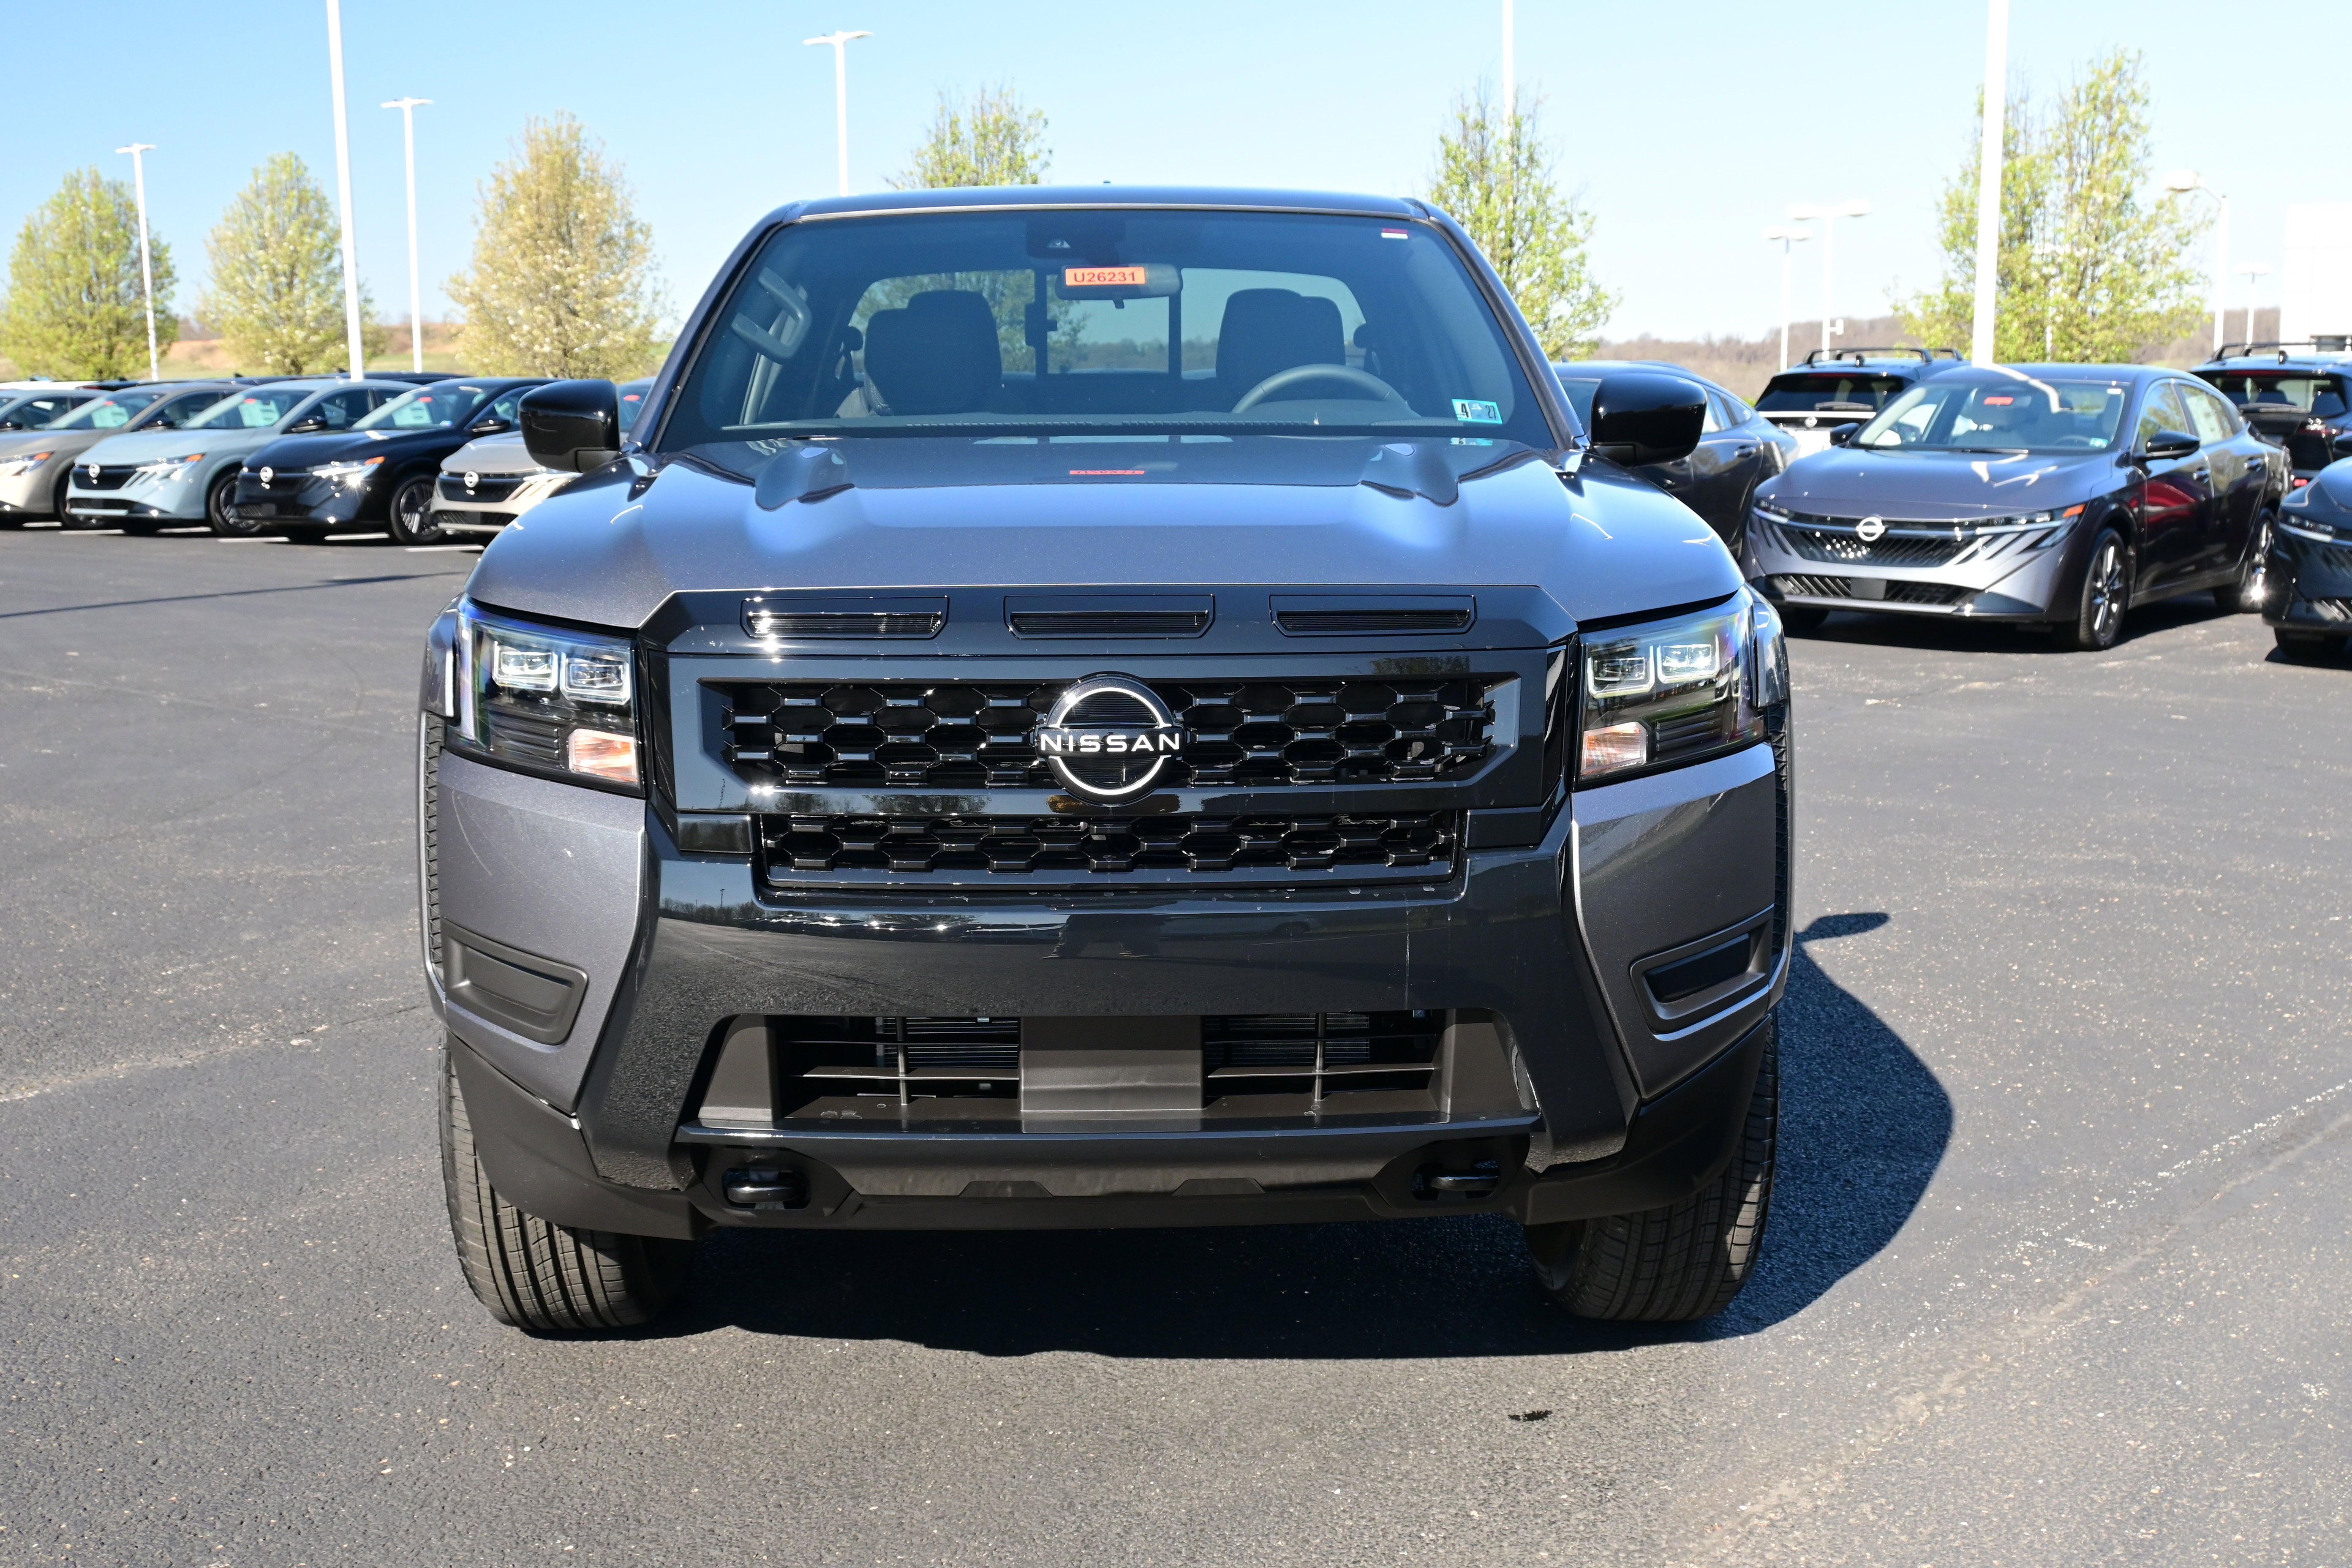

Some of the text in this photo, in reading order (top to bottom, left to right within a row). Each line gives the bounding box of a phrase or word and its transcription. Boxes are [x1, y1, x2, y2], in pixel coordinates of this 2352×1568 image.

[1074, 271, 1135, 283] U26231
[1461, 403, 1496, 419] 4 27
[1040, 733, 1180, 752] NISSAN
